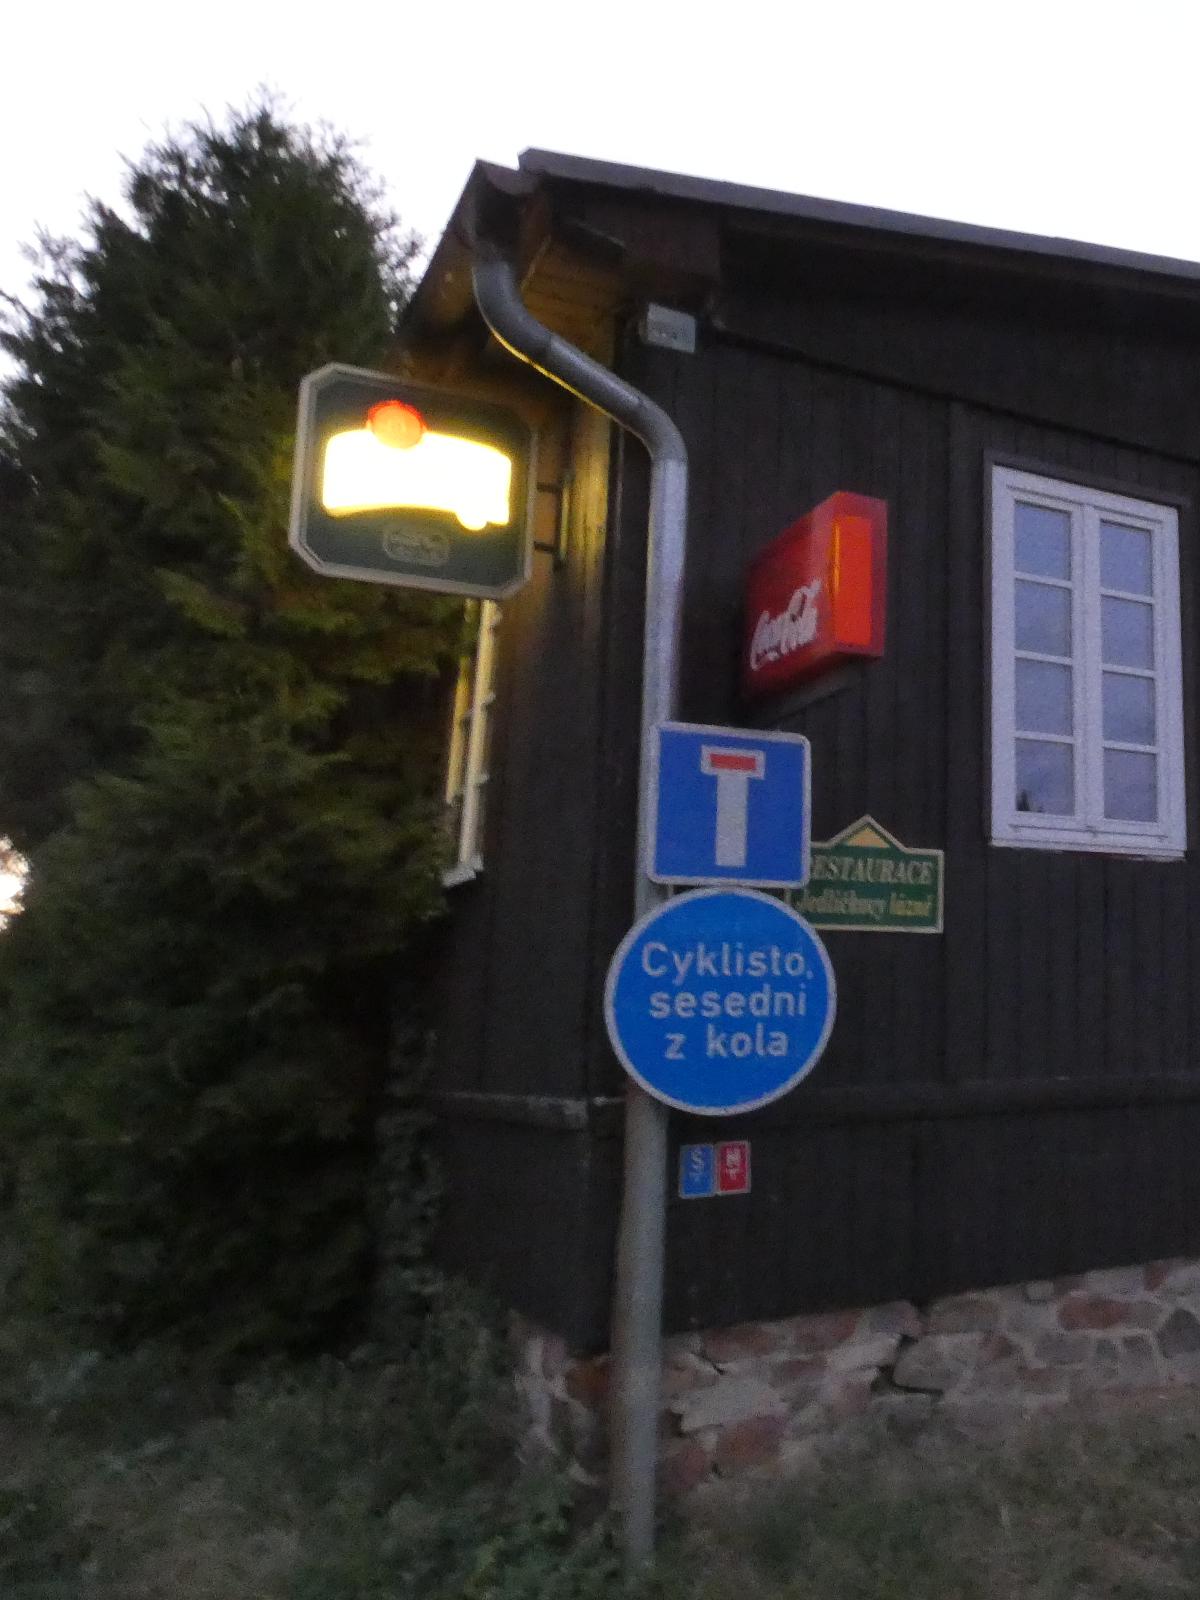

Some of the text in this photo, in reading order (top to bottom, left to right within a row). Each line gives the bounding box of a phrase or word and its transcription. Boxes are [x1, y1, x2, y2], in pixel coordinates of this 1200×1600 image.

[810, 856, 932, 884] ESTAURACE
[642, 941, 814, 986] Cyklisto,
[650, 983, 807, 1018] sesedni
[665, 1022, 789, 1060] z kola
